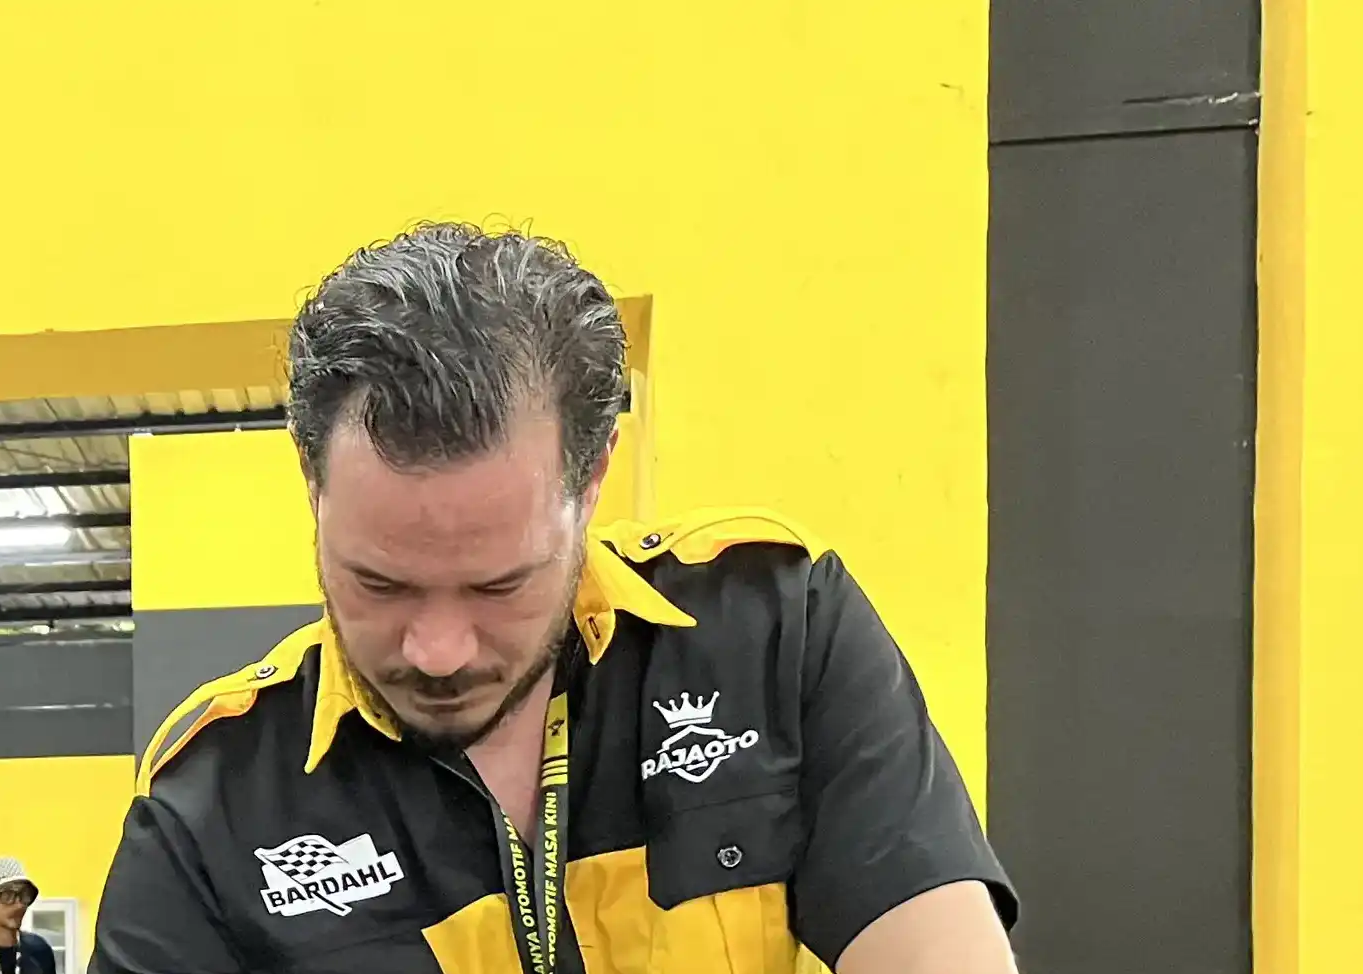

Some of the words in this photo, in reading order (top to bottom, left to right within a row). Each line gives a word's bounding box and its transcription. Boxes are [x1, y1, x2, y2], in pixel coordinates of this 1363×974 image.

[641, 729, 759, 780] RAJAOTO
[544, 792, 556, 825] KINI
[545, 830, 557, 877] MASA
[267, 861, 396, 908] BARDAHL
[510, 843, 535, 927] OTOMOTIF
